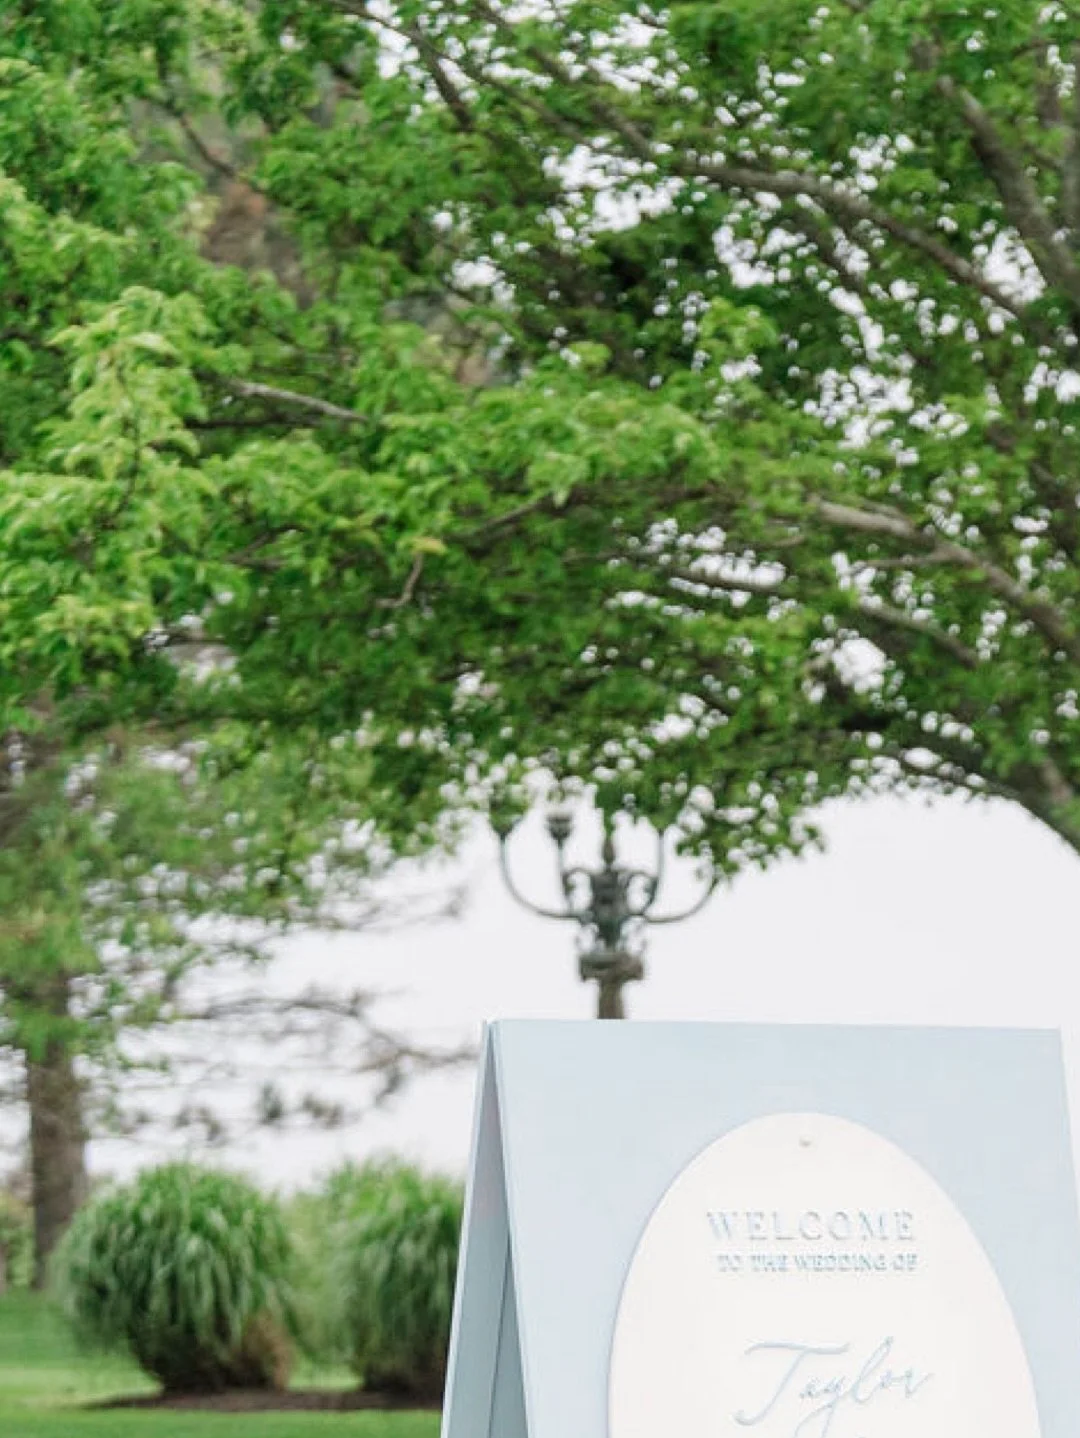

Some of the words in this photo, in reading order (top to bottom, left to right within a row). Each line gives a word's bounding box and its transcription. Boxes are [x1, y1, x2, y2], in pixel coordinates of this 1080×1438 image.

[707, 1210, 915, 1241] WELCOME
[717, 1254, 742, 1272] TO
[751, 1254, 790, 1272] THE
[795, 1253, 888, 1272] WEDDING
[892, 1253, 918, 1271] OF
